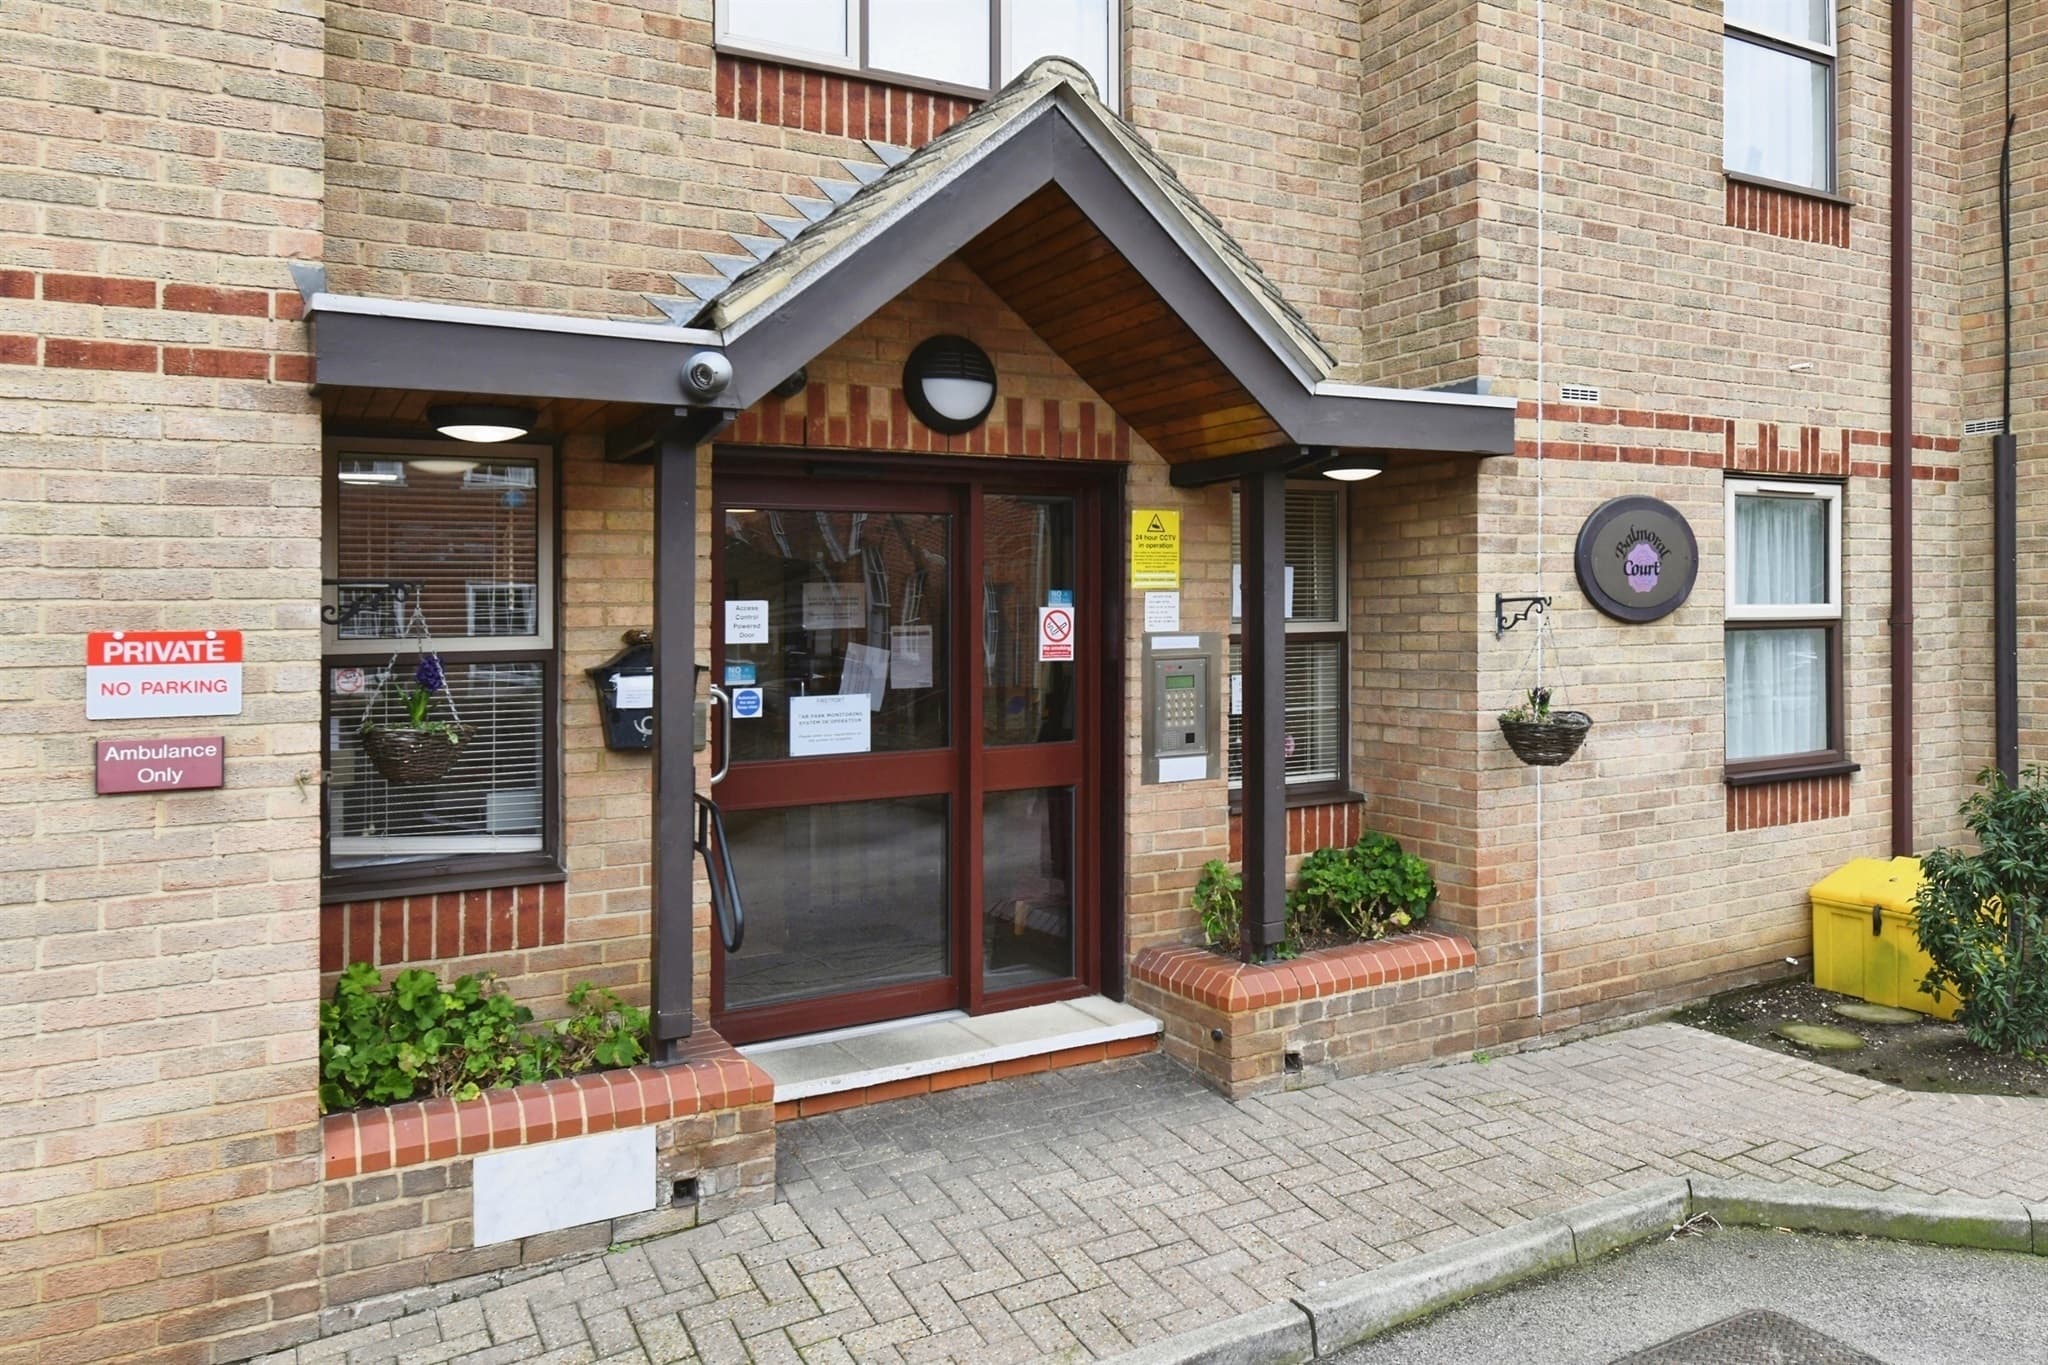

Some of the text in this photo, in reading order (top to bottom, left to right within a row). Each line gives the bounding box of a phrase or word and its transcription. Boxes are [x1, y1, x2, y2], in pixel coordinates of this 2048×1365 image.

[1615, 524, 1672, 560] Balmoral
[1623, 560, 1662, 576] Court
[103, 639, 225, 663] PRIVATE
[101, 679, 228, 696] NO PARKING
[104, 744, 217, 761] Ambulance
[137, 768, 183, 784] Only
